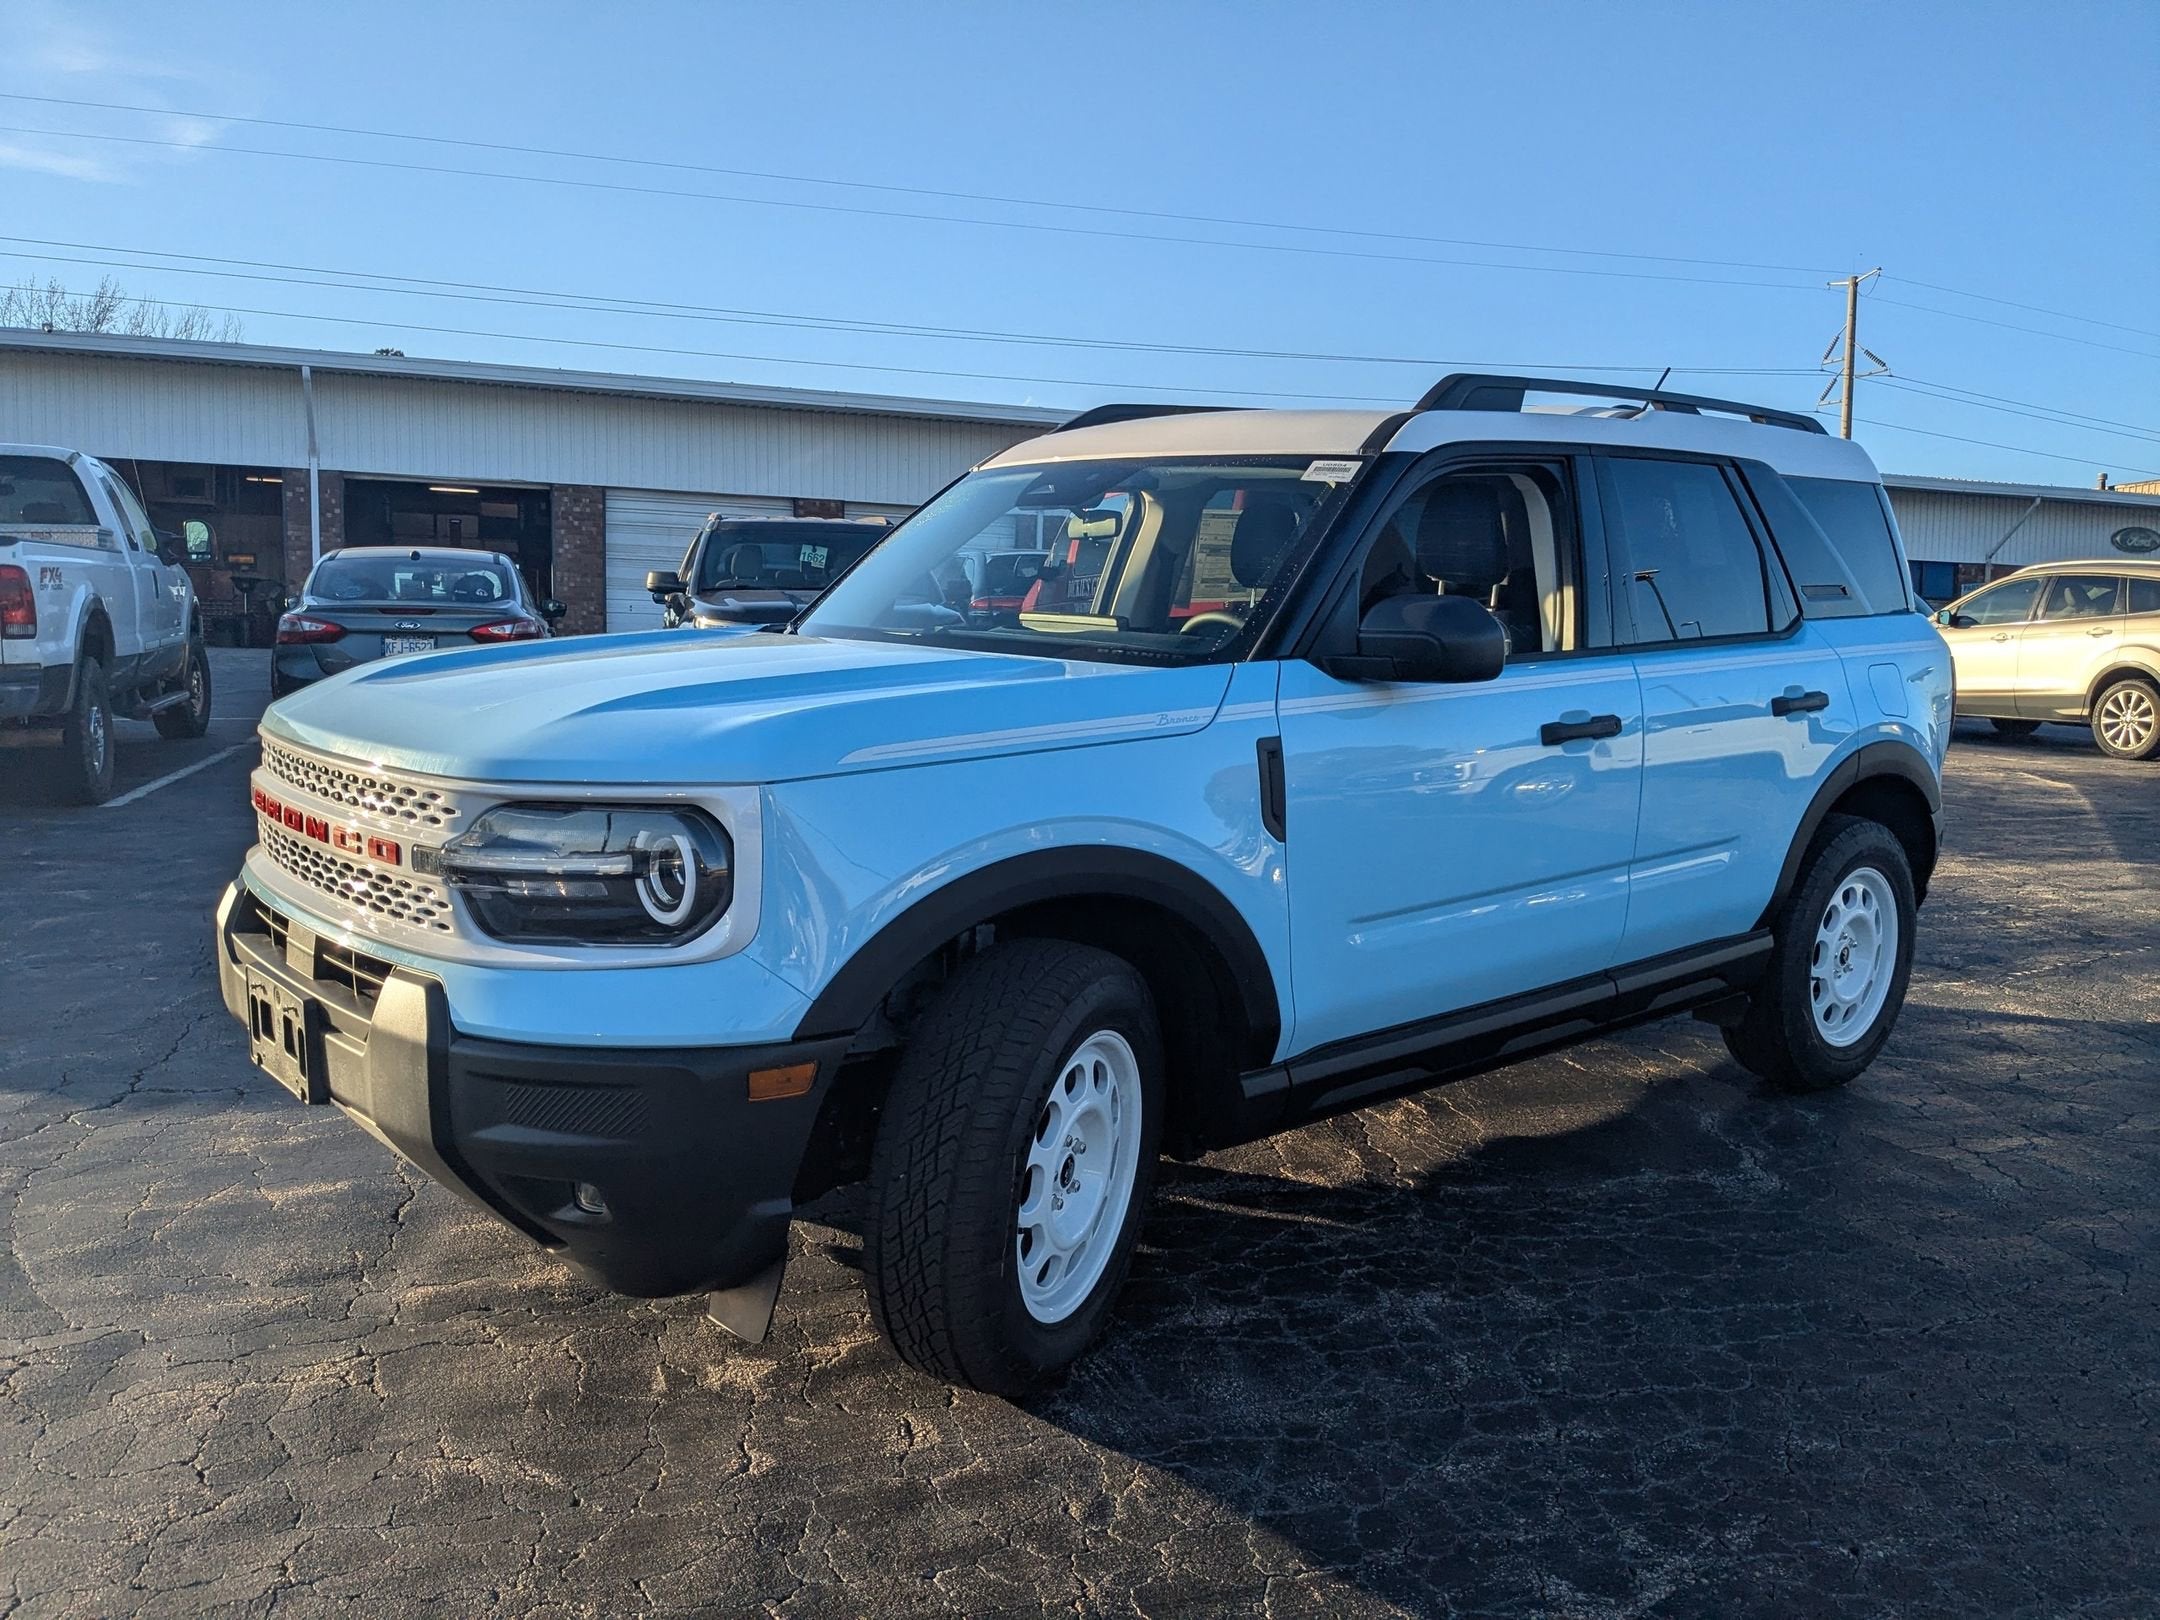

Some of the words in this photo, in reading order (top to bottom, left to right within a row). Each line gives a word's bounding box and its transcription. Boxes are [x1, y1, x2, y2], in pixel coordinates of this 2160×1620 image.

[801, 552, 825, 563] 1662
[40, 567, 62, 583] FX4
[1156, 713, 1200, 727] Bronco
[254, 788, 403, 866] BRONCO
